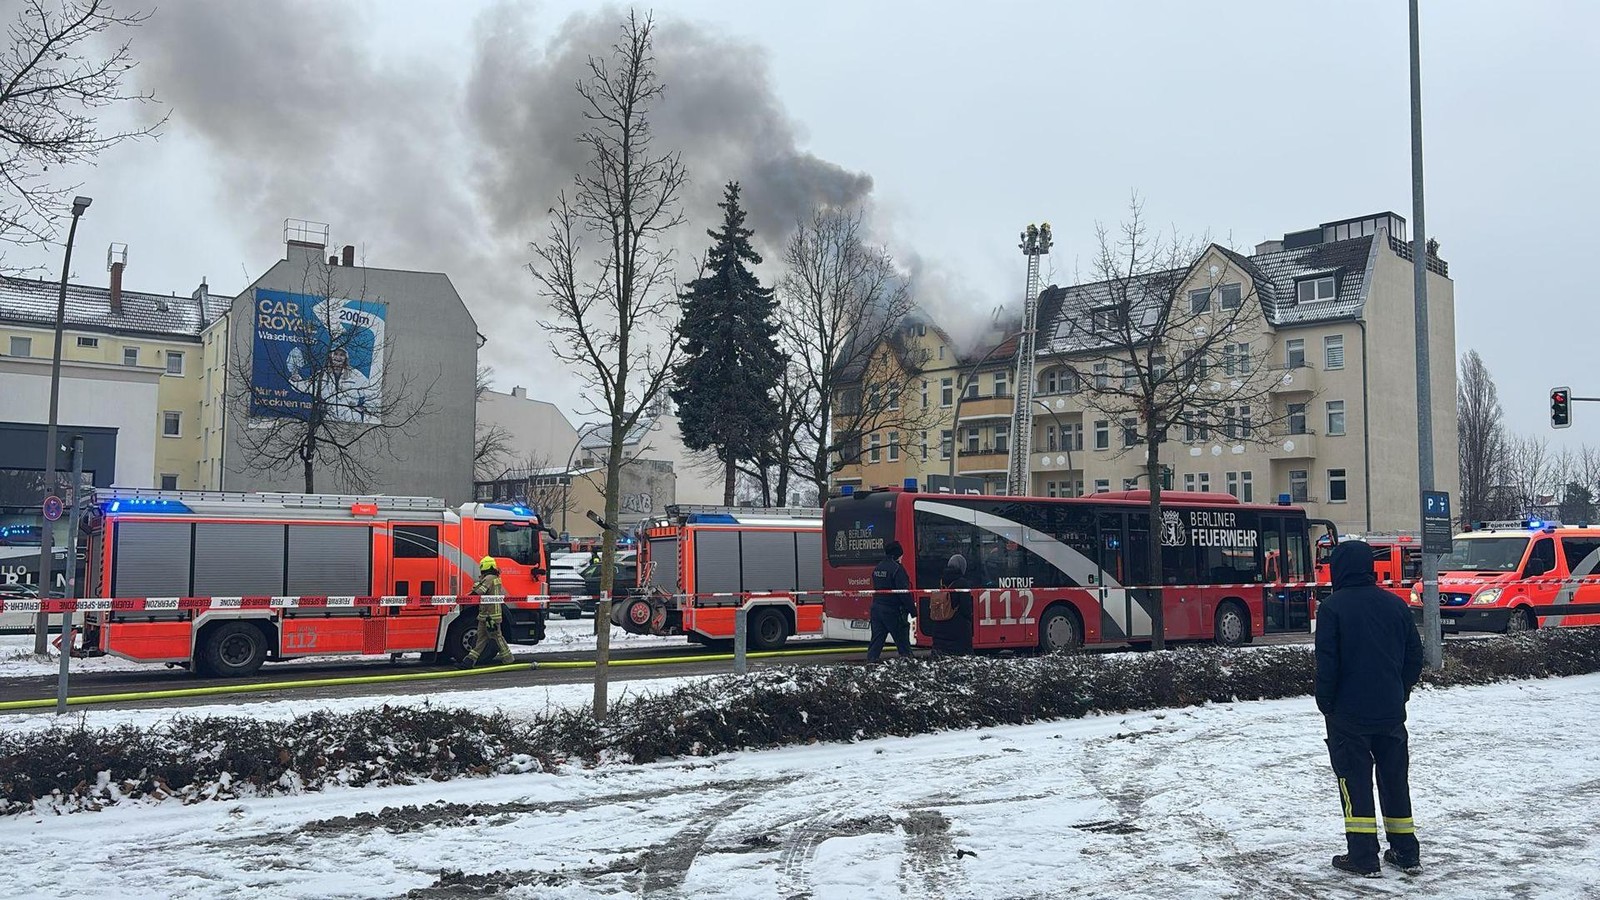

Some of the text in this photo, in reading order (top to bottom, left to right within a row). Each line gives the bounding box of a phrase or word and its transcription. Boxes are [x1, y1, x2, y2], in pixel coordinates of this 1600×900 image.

[259, 299, 299, 317] CAR
[258, 313, 318, 334] ROYA
[339, 309, 370, 325] 200m
[274, 388, 289, 397] wir
[1190, 511, 1237, 527] BERLINER
[1486, 521, 1521, 529] Feuerwehr
[848, 529, 872, 538] BERLINER
[1191, 528, 1258, 547] FEUERWEHR
[848, 538, 884, 550] FEUERWEHR
[998, 576, 1034, 588] NOTRUF
[59, 600, 134, 610] FEUERWEHR-SPERRZONE
[979, 590, 1035, 626] 112
[286, 632, 317, 648] 112
